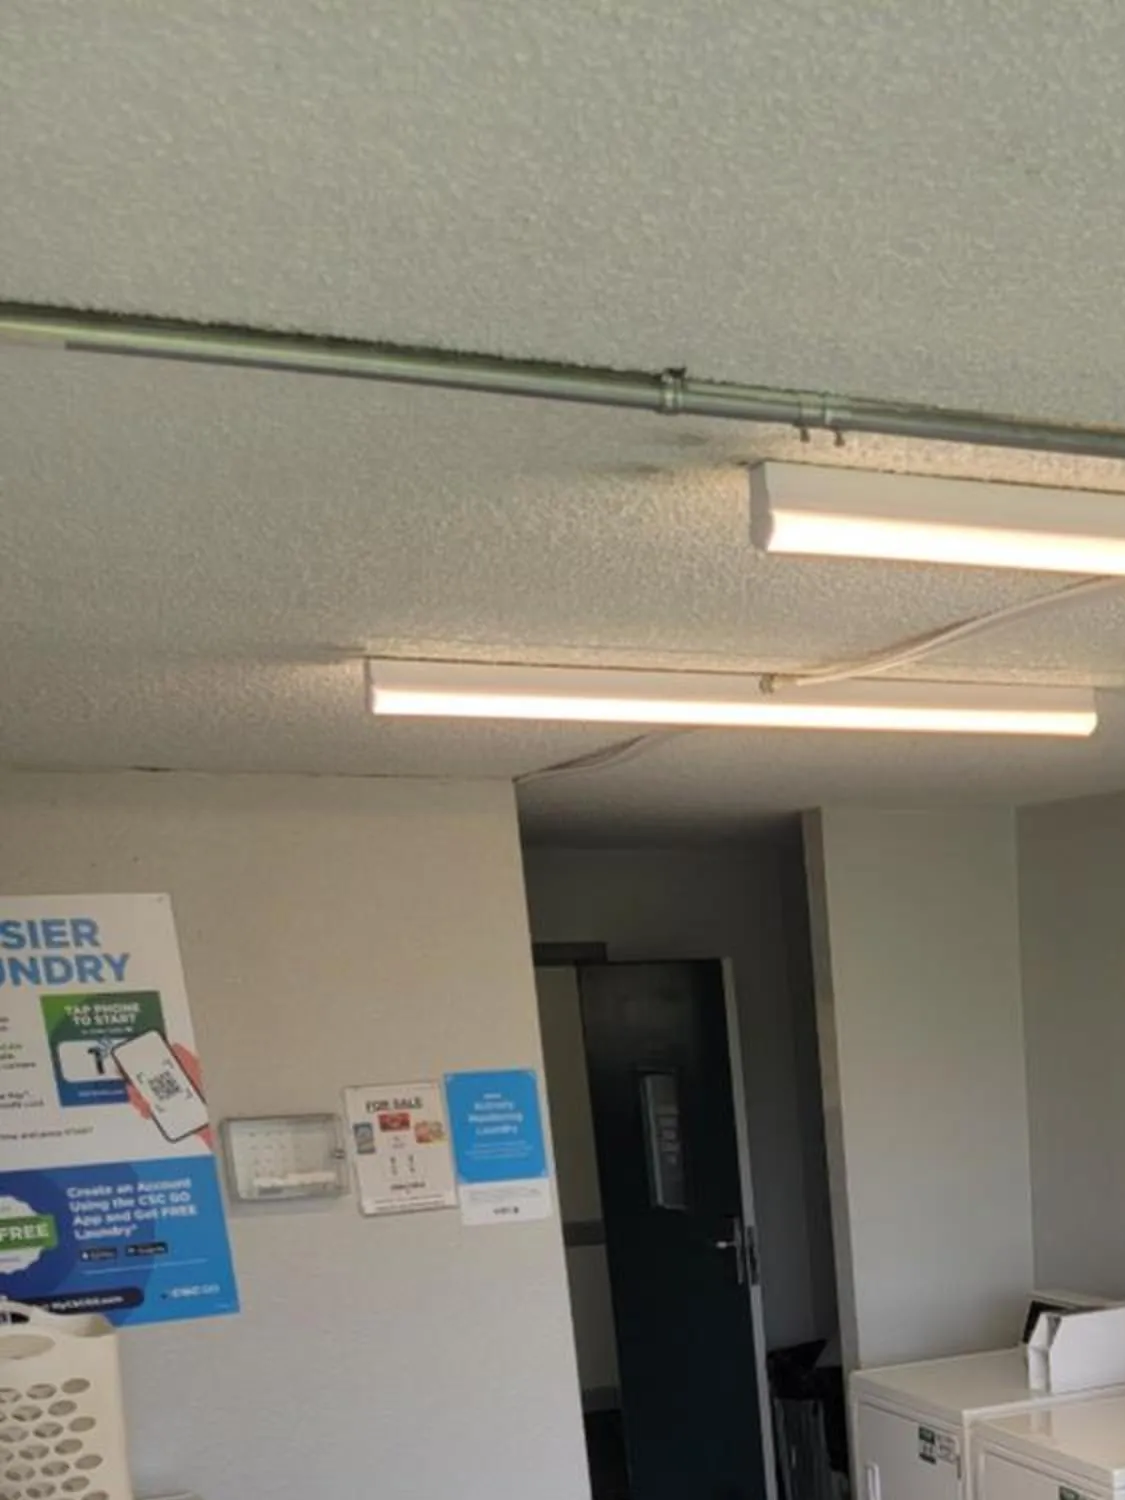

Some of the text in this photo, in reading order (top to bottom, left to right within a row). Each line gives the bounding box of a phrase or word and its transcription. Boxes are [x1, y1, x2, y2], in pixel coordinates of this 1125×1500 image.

[365, 1096, 424, 1113] FOR SALE
[161, 1205, 197, 1217] FREE
[0, 1223, 50, 1241] FREE
